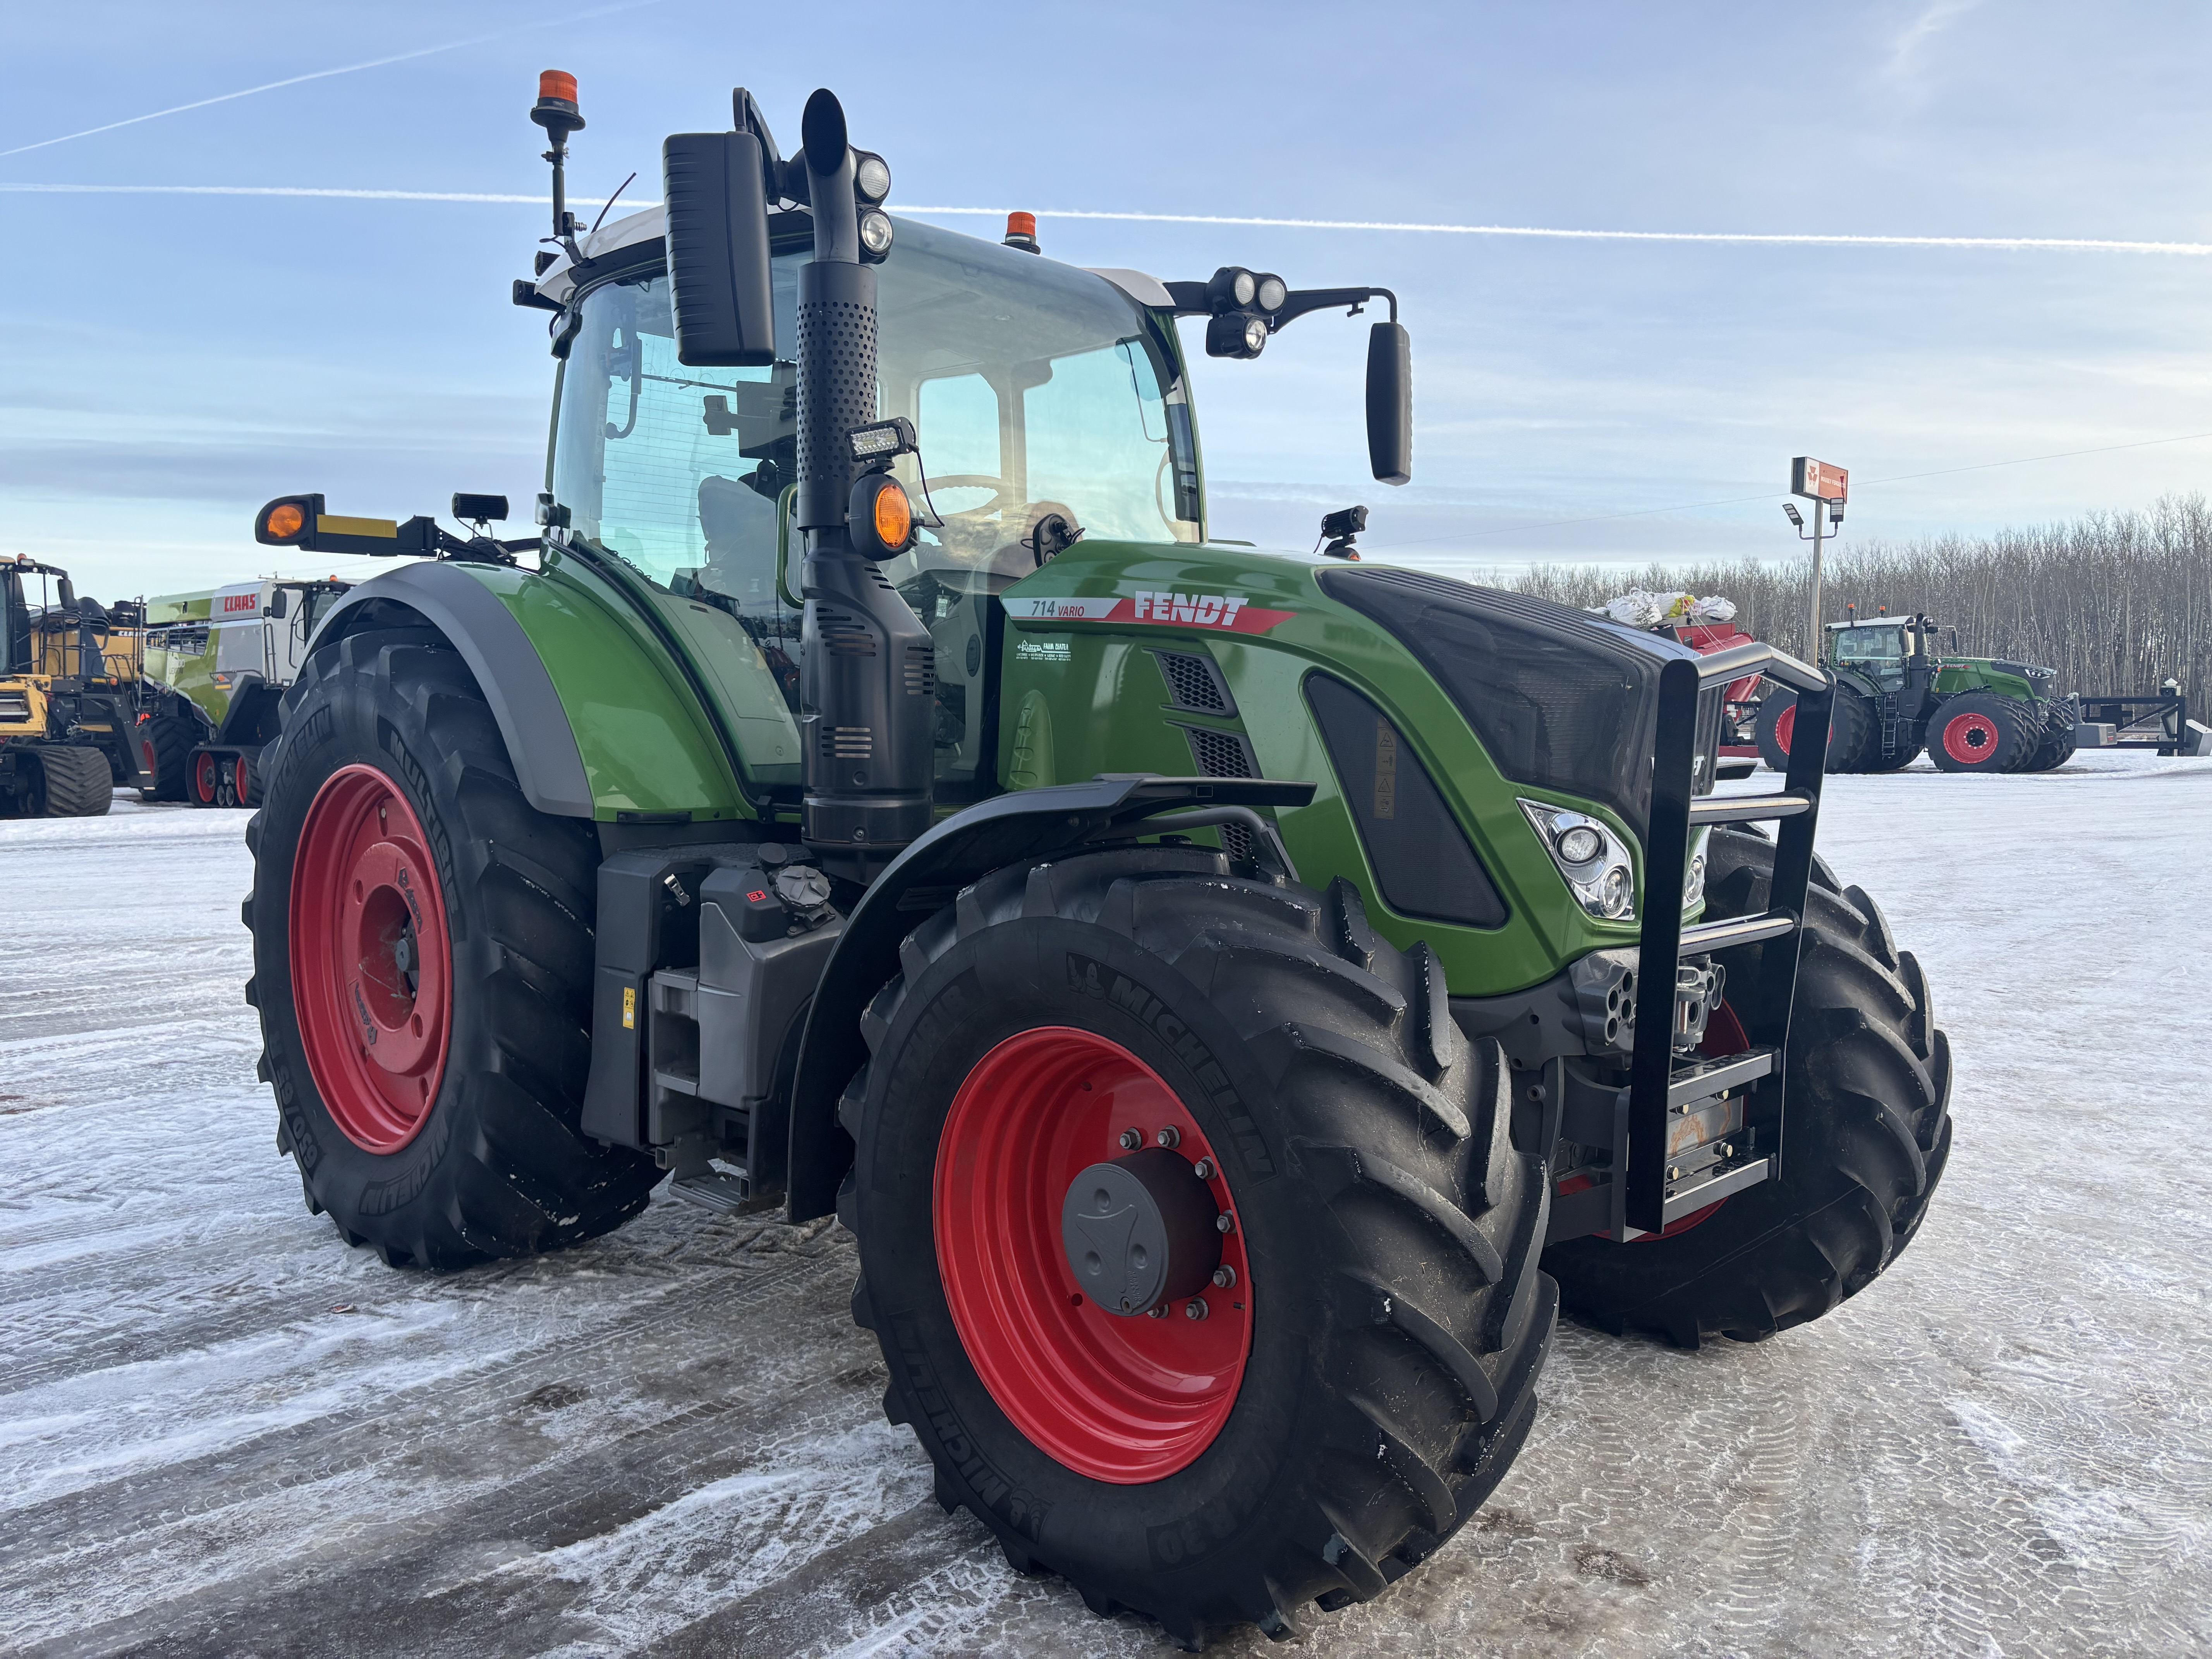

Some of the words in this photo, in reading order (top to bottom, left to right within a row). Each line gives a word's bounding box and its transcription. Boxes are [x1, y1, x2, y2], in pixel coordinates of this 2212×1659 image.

[224, 593, 256, 612] CLAAS
[1032, 601, 1055, 616] 714
[1058, 606, 1084, 617] VARIO
[1135, 591, 1249, 626] FENDT
[269, 704, 331, 828] MICHELIN
[390, 730, 459, 914] MULTIBIB
[274, 1061, 319, 1175] 650/65
[1110, 974, 1273, 1178] MICHELIN
[360, 1111, 451, 1216] MICHELIN
[891, 1316, 1007, 1510] MICHELIN
[1154, 1517, 1206, 1565] 30
